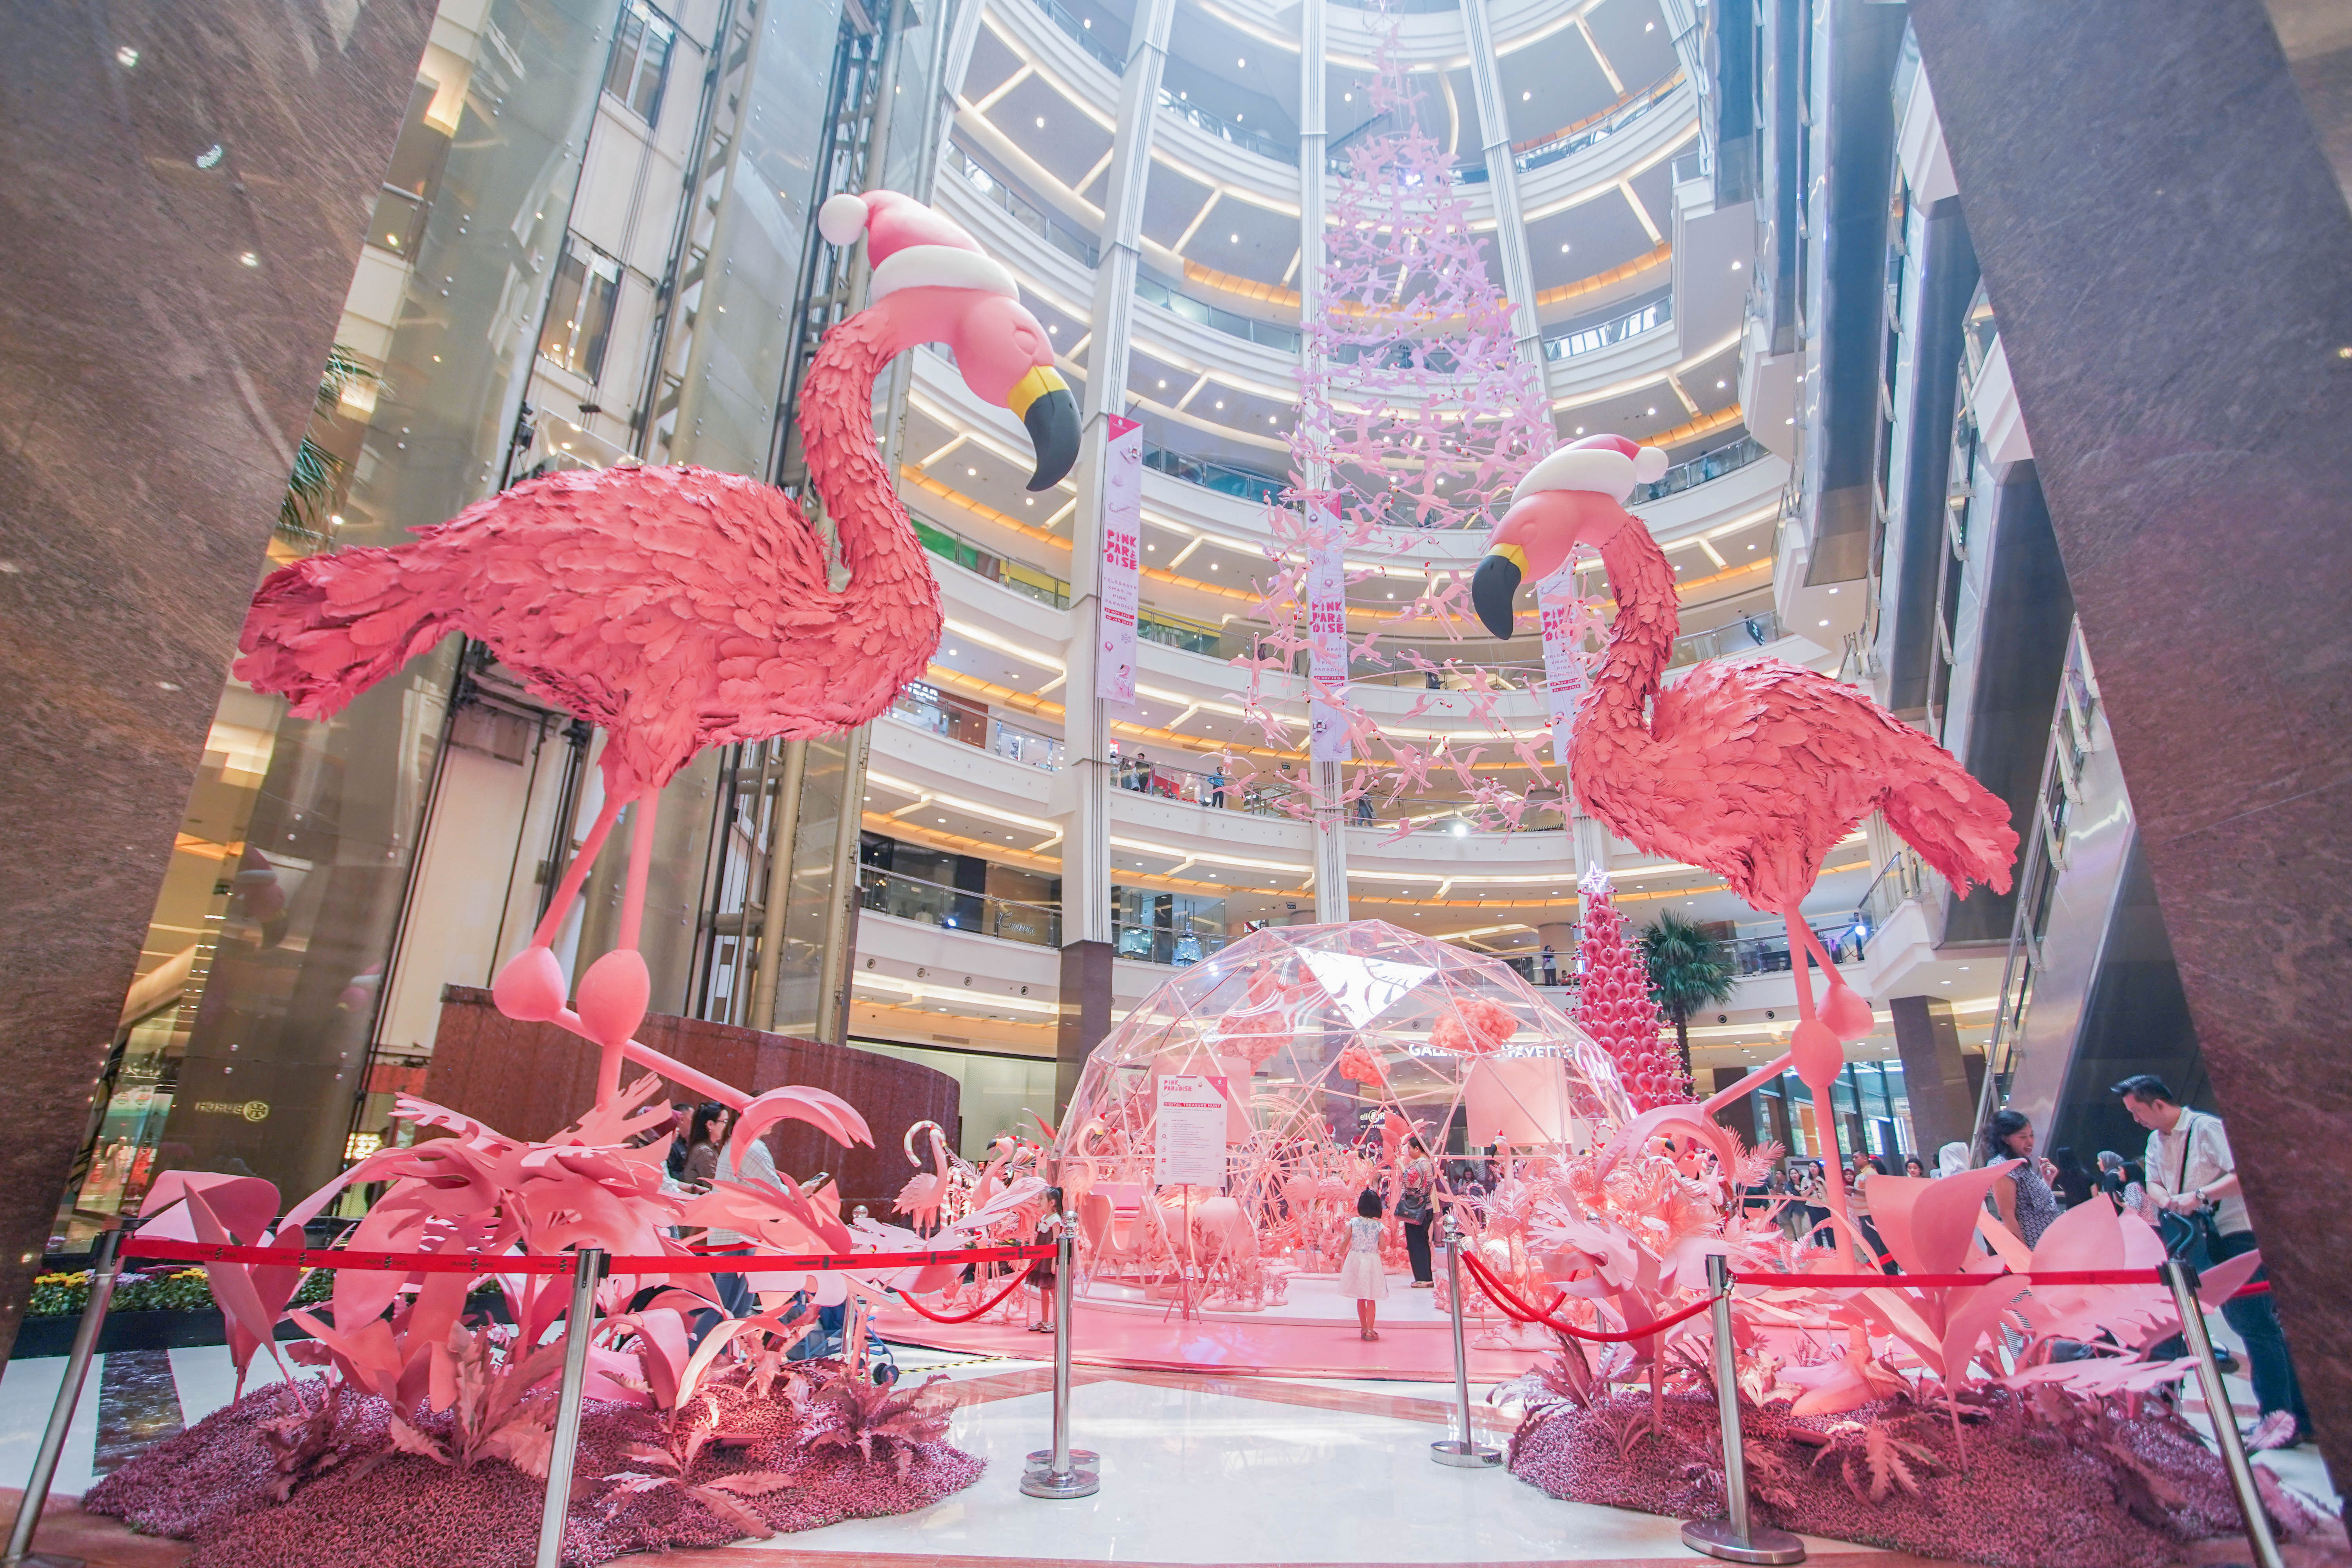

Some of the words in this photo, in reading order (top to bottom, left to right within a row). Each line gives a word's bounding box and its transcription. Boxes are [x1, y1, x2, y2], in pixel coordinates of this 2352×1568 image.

[1107, 529, 1137, 547] PINK
[1104, 577, 1137, 590] CELEBRATE
[1105, 599, 1134, 610] PARADISE
[1312, 602, 1343, 611] PINK
[998, 911, 1035, 935] Crown
